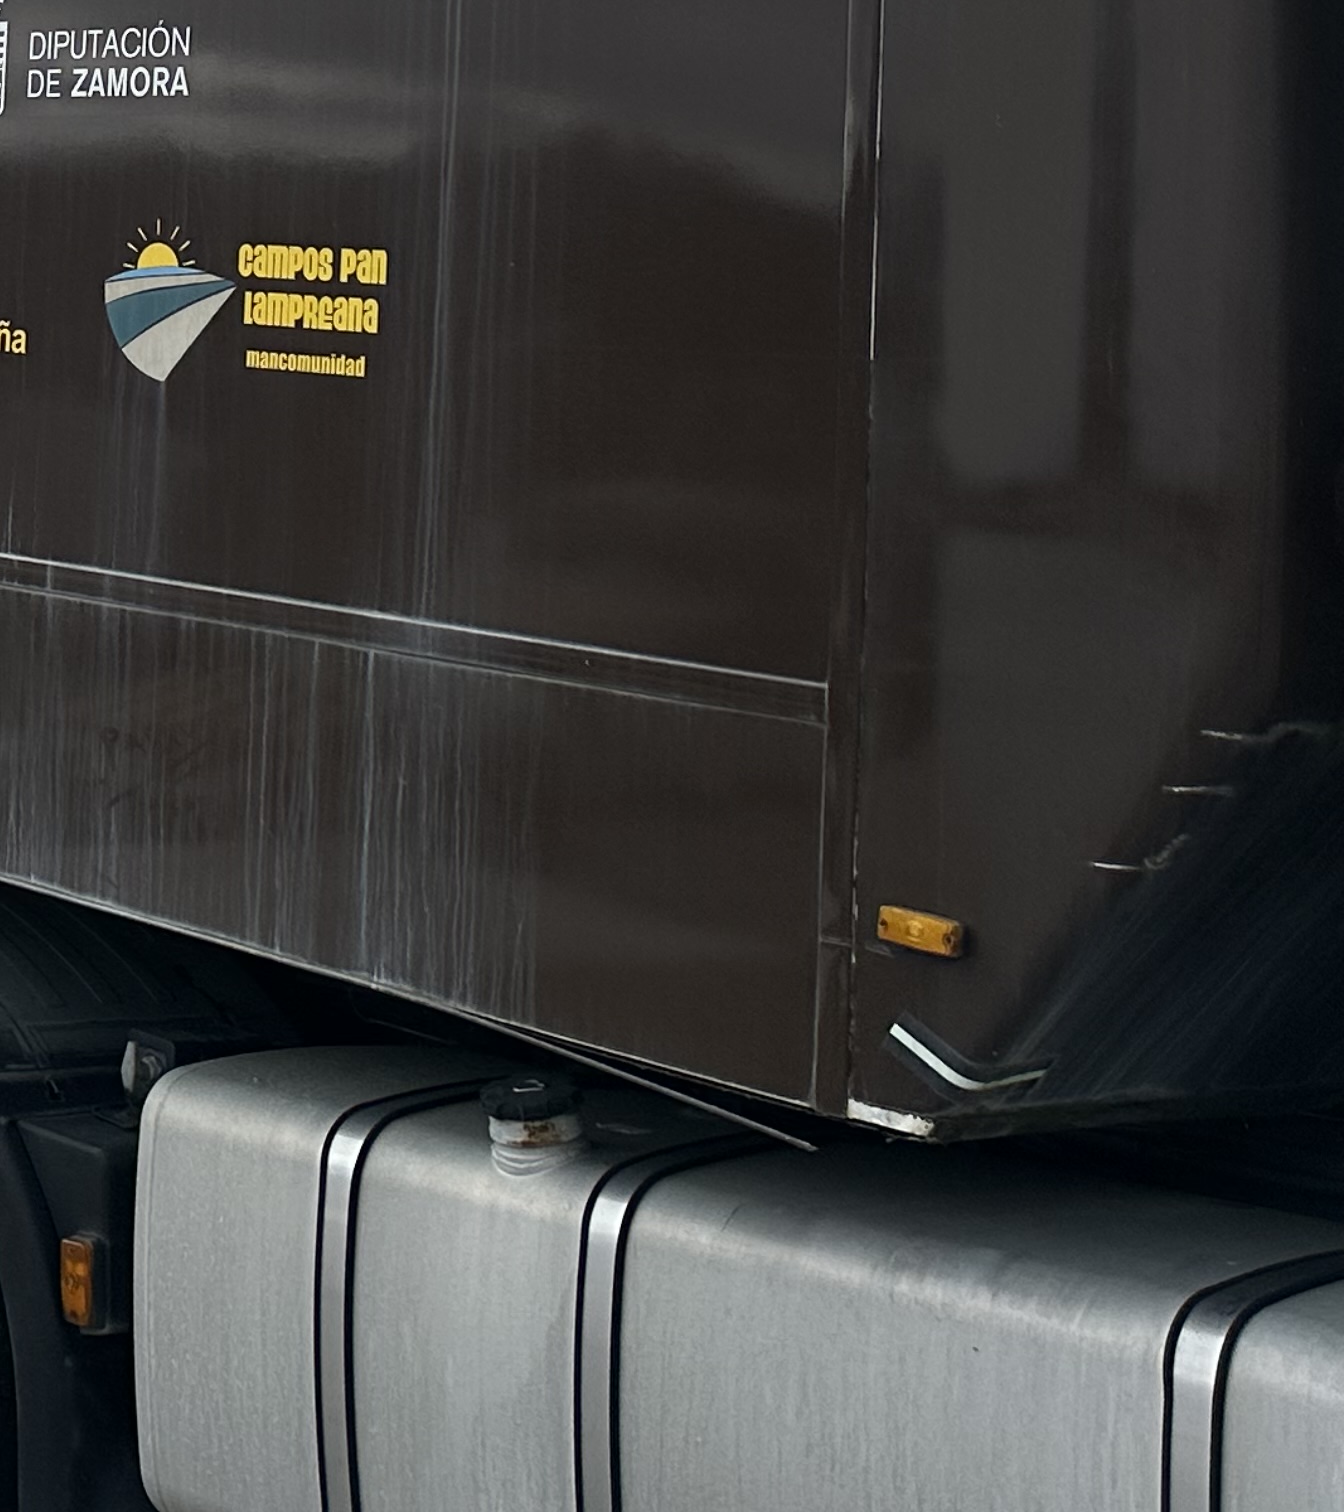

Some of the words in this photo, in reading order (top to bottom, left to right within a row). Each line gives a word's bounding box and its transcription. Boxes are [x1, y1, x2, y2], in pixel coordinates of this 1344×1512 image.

[29, 19, 191, 60] DIPUTACIÓN
[26, 68, 62, 98] DE
[70, 66, 190, 98] ZAMORA
[246, 349, 366, 378] mancomunidad
